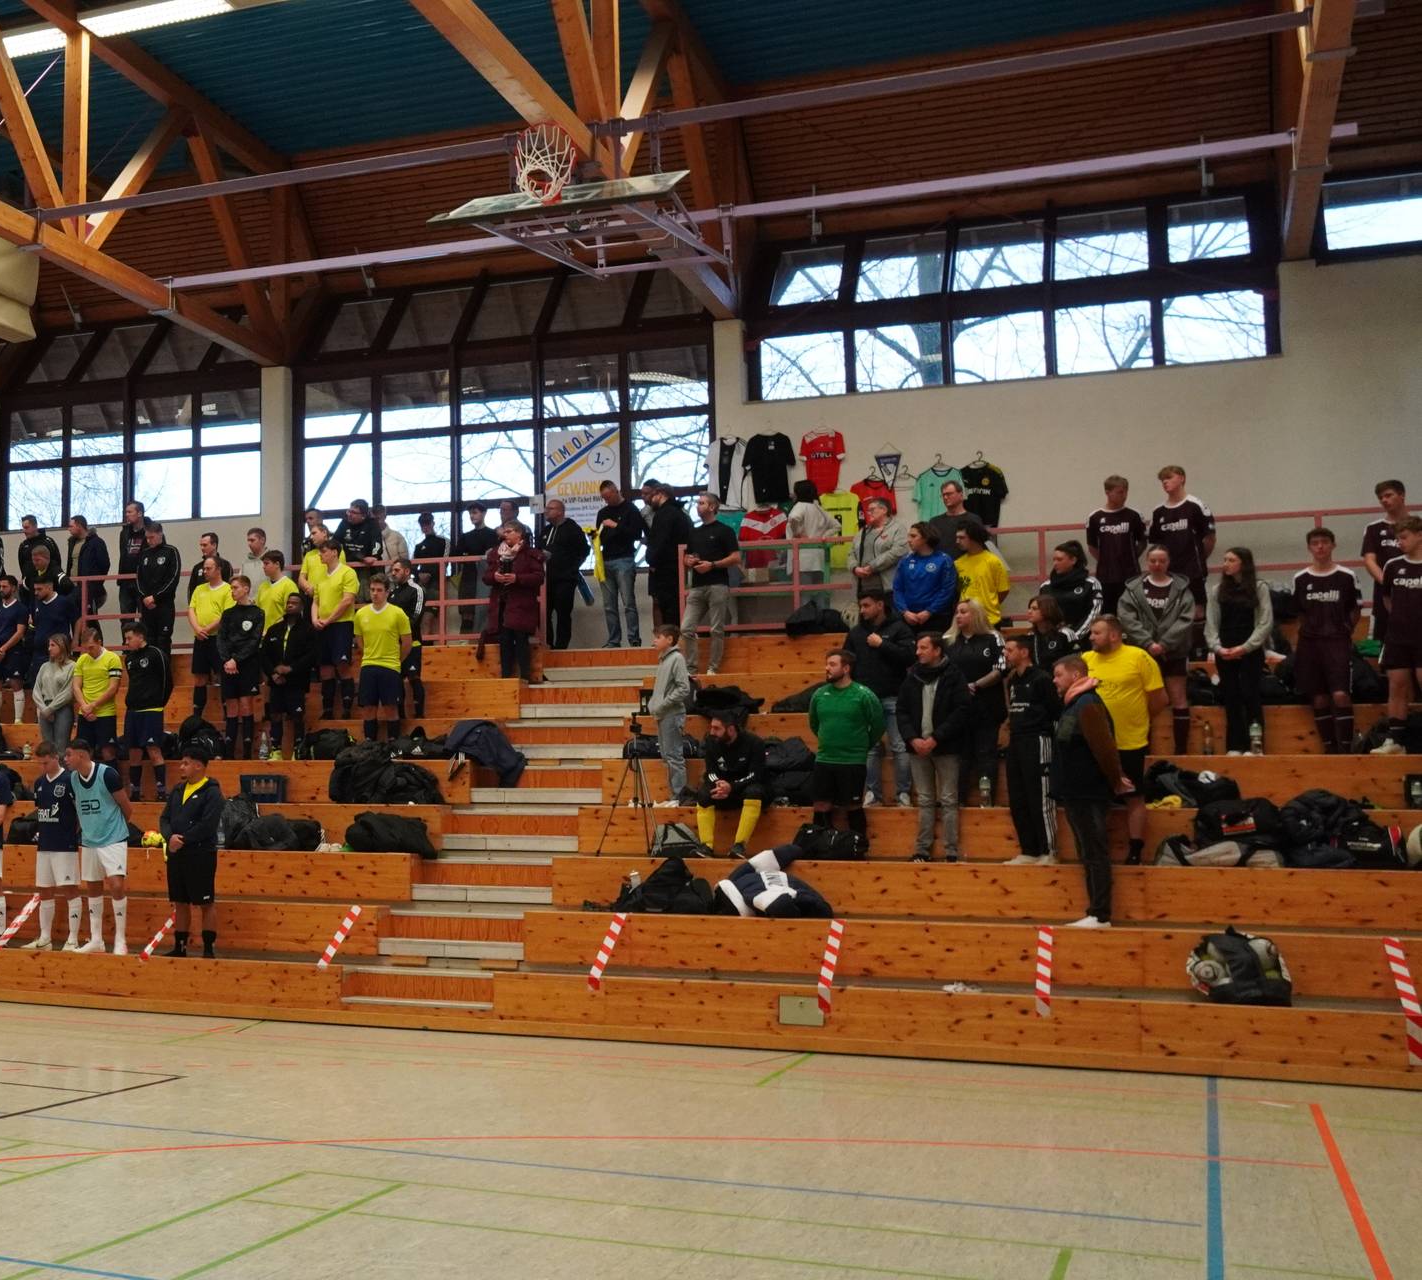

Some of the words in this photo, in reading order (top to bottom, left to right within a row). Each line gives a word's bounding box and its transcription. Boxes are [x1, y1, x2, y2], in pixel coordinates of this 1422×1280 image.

[547, 430, 595, 467] TOMBOLA
[1099, 522, 1130, 534] capelli
[1160, 519, 1188, 531] capelli
[1306, 590, 1340, 602] capelli
[81, 799, 100, 811] SD
